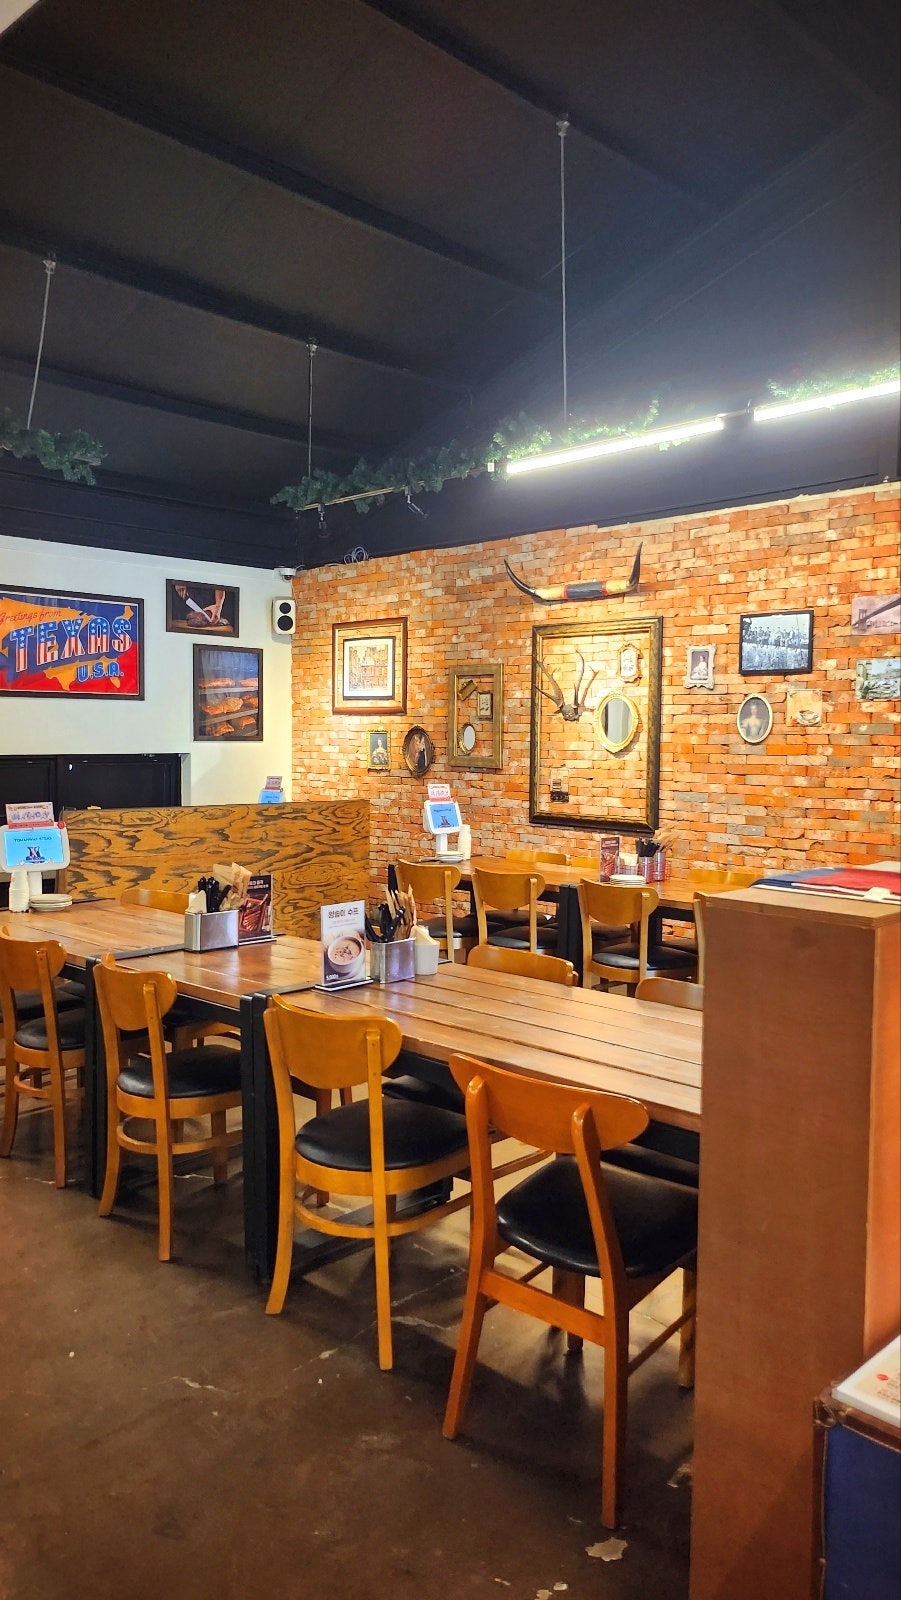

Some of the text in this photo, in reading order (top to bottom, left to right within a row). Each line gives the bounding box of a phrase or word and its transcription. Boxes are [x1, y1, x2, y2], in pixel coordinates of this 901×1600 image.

[39, 608, 62, 622] from
[9, 616, 133, 674] TEXAS
[77, 661, 125, 683] U.S.A.
[347, 907, 359, 916] 수프
